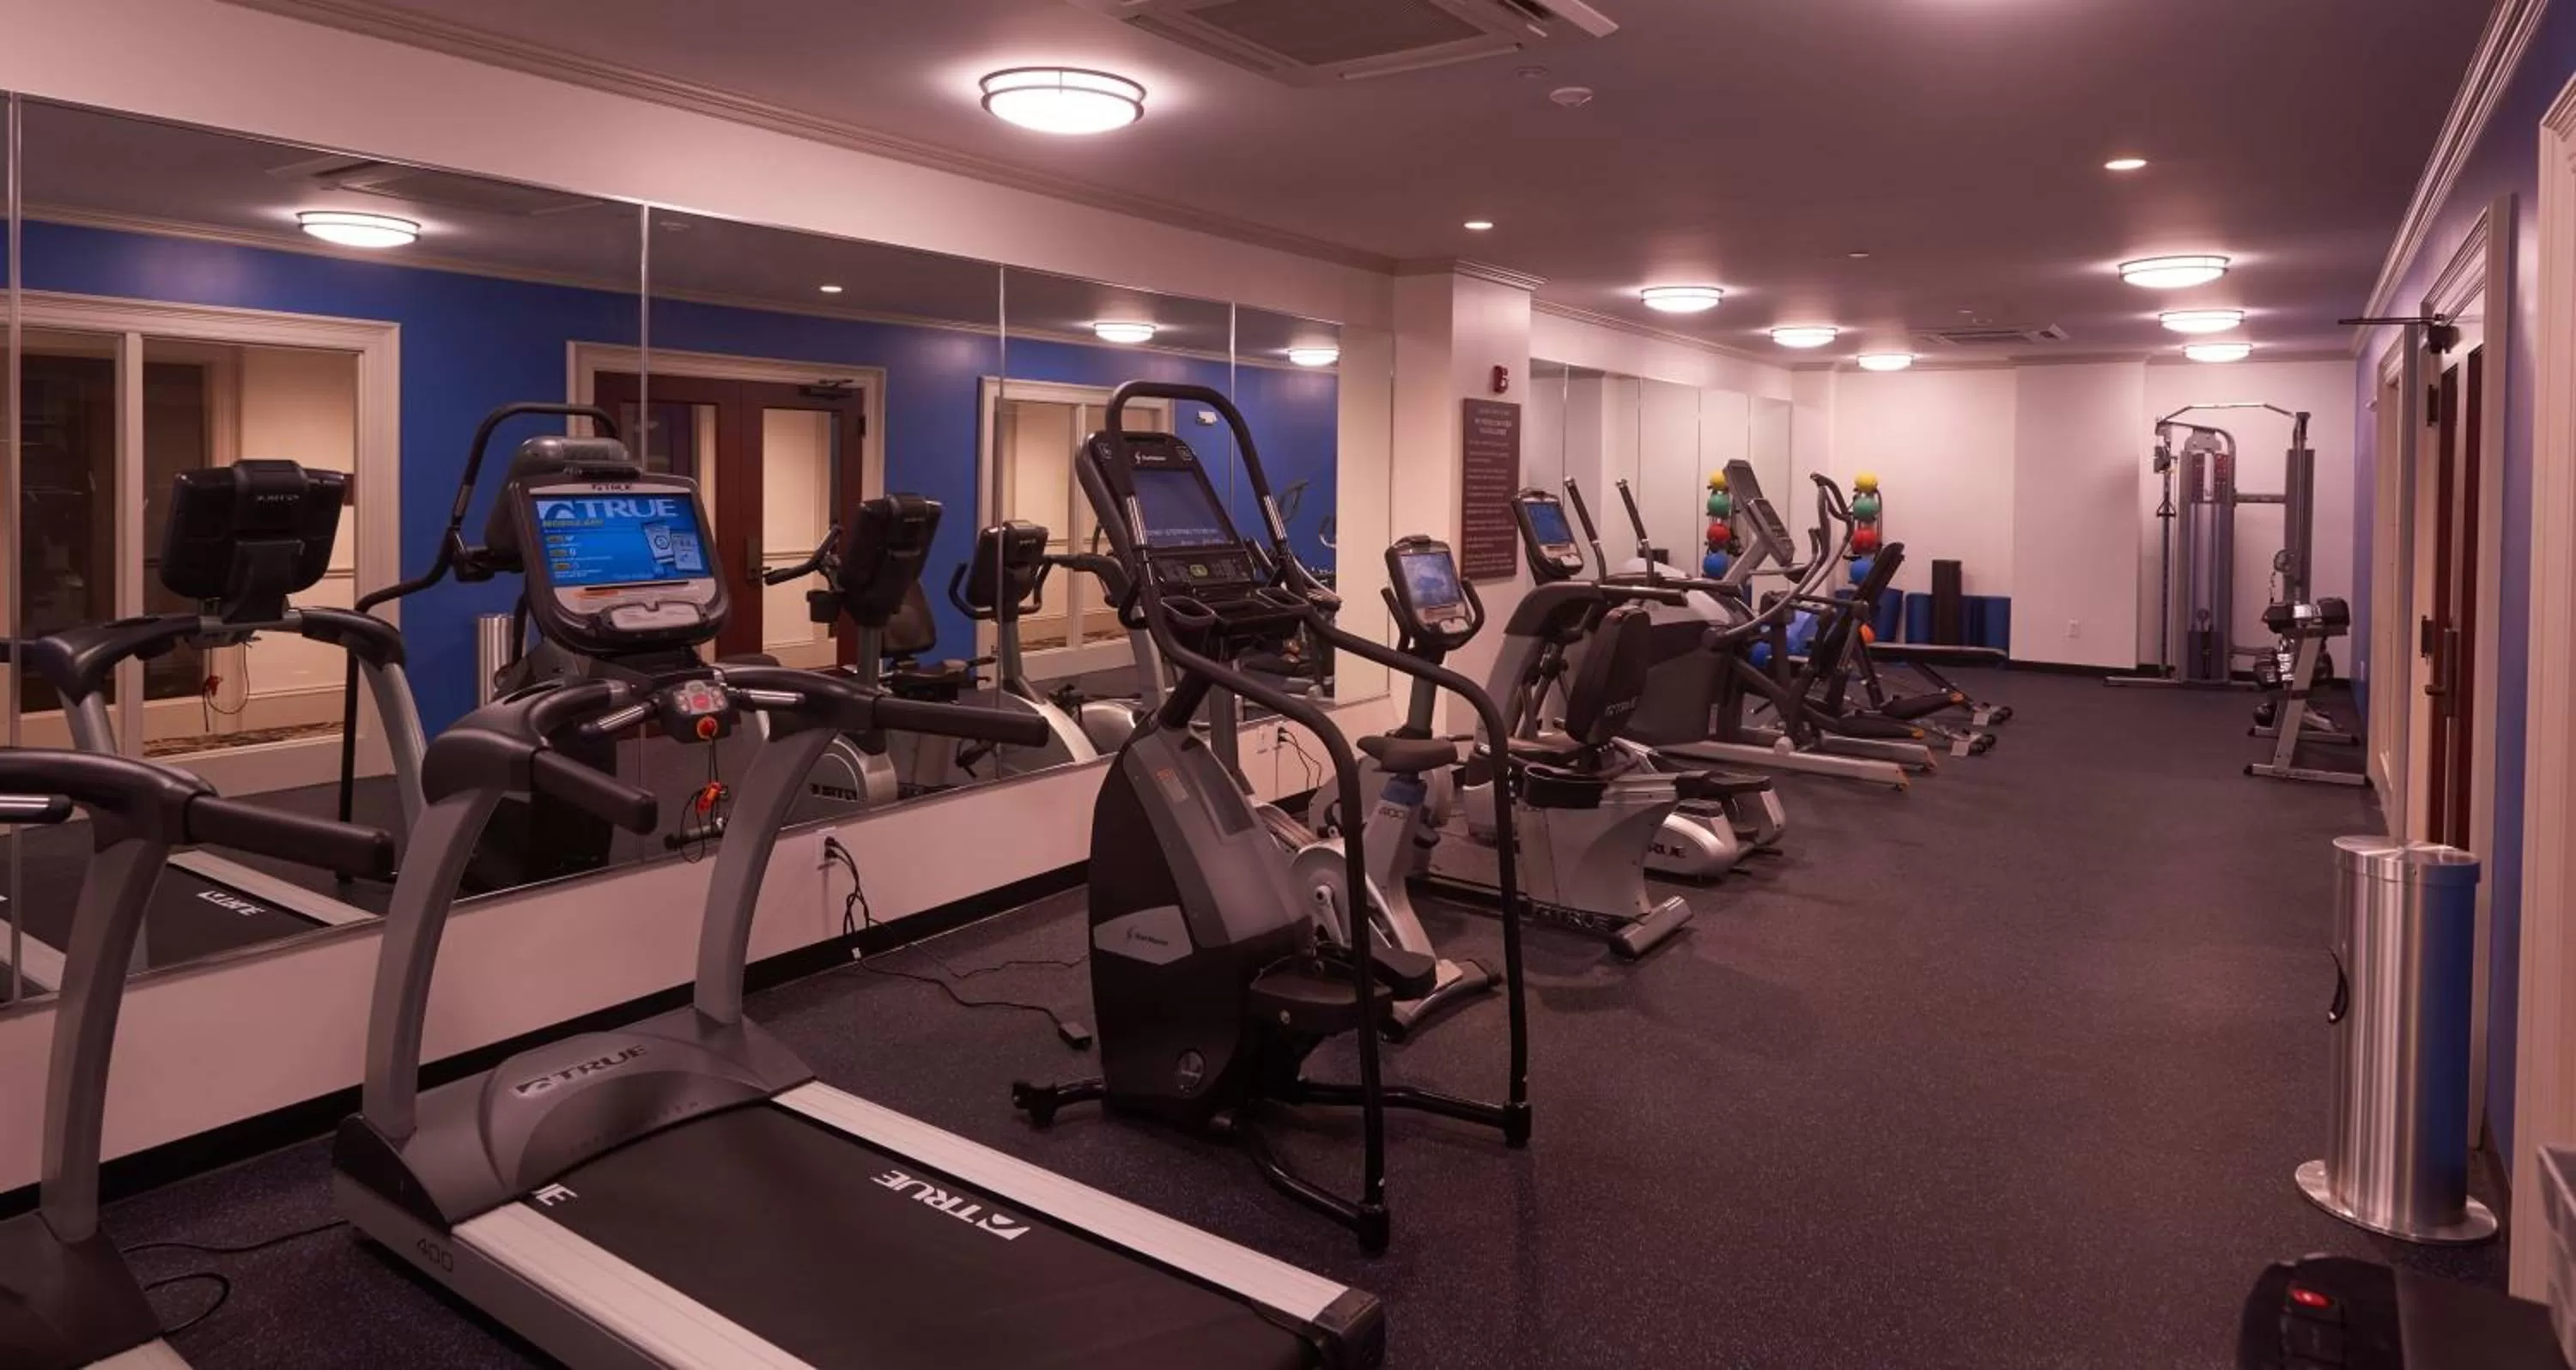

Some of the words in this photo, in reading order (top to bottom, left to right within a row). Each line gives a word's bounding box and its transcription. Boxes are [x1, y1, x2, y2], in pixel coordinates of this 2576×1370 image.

[575, 498, 678, 518] TRUE
[1647, 843, 1687, 859] RUE
[556, 1044, 647, 1081] TRUE
[870, 1169, 983, 1223] TRUE
